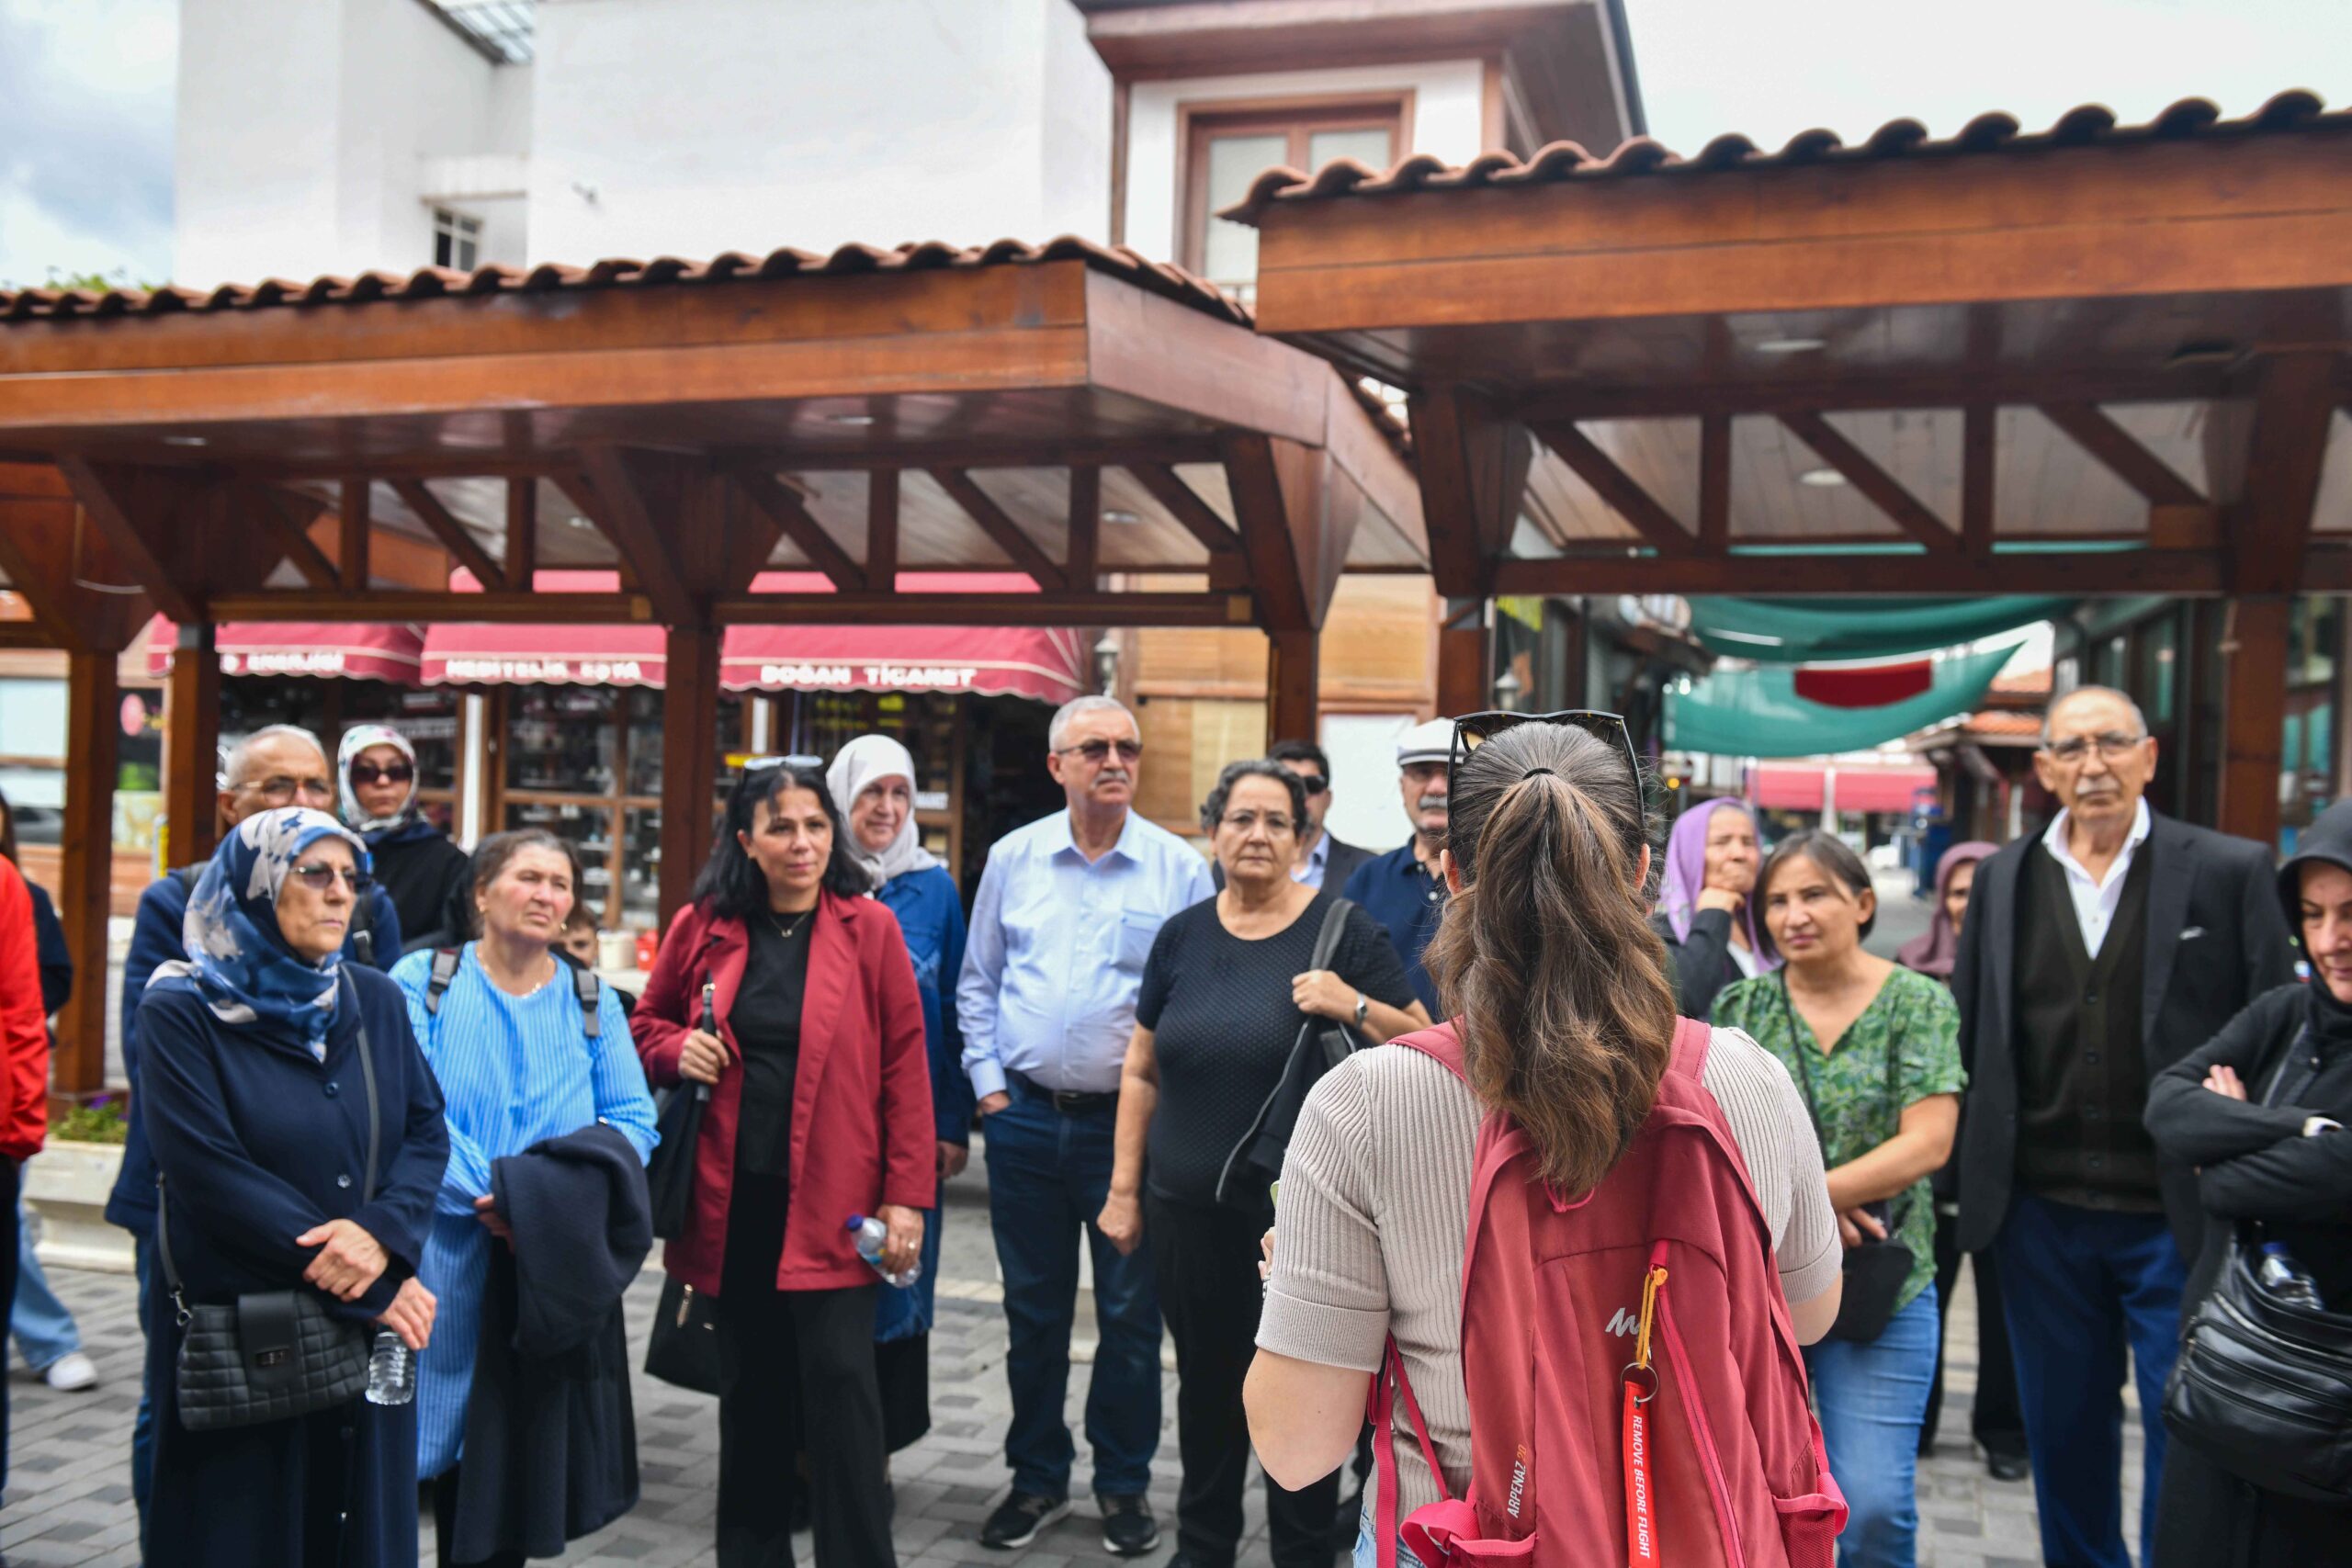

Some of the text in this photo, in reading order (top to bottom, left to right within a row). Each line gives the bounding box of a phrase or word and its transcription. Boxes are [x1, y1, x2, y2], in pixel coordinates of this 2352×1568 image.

[1507, 1443, 1527, 1518] ARPENAZ 20
[1634, 1415, 1650, 1559] REMOVE BEFORE FLIGHT
